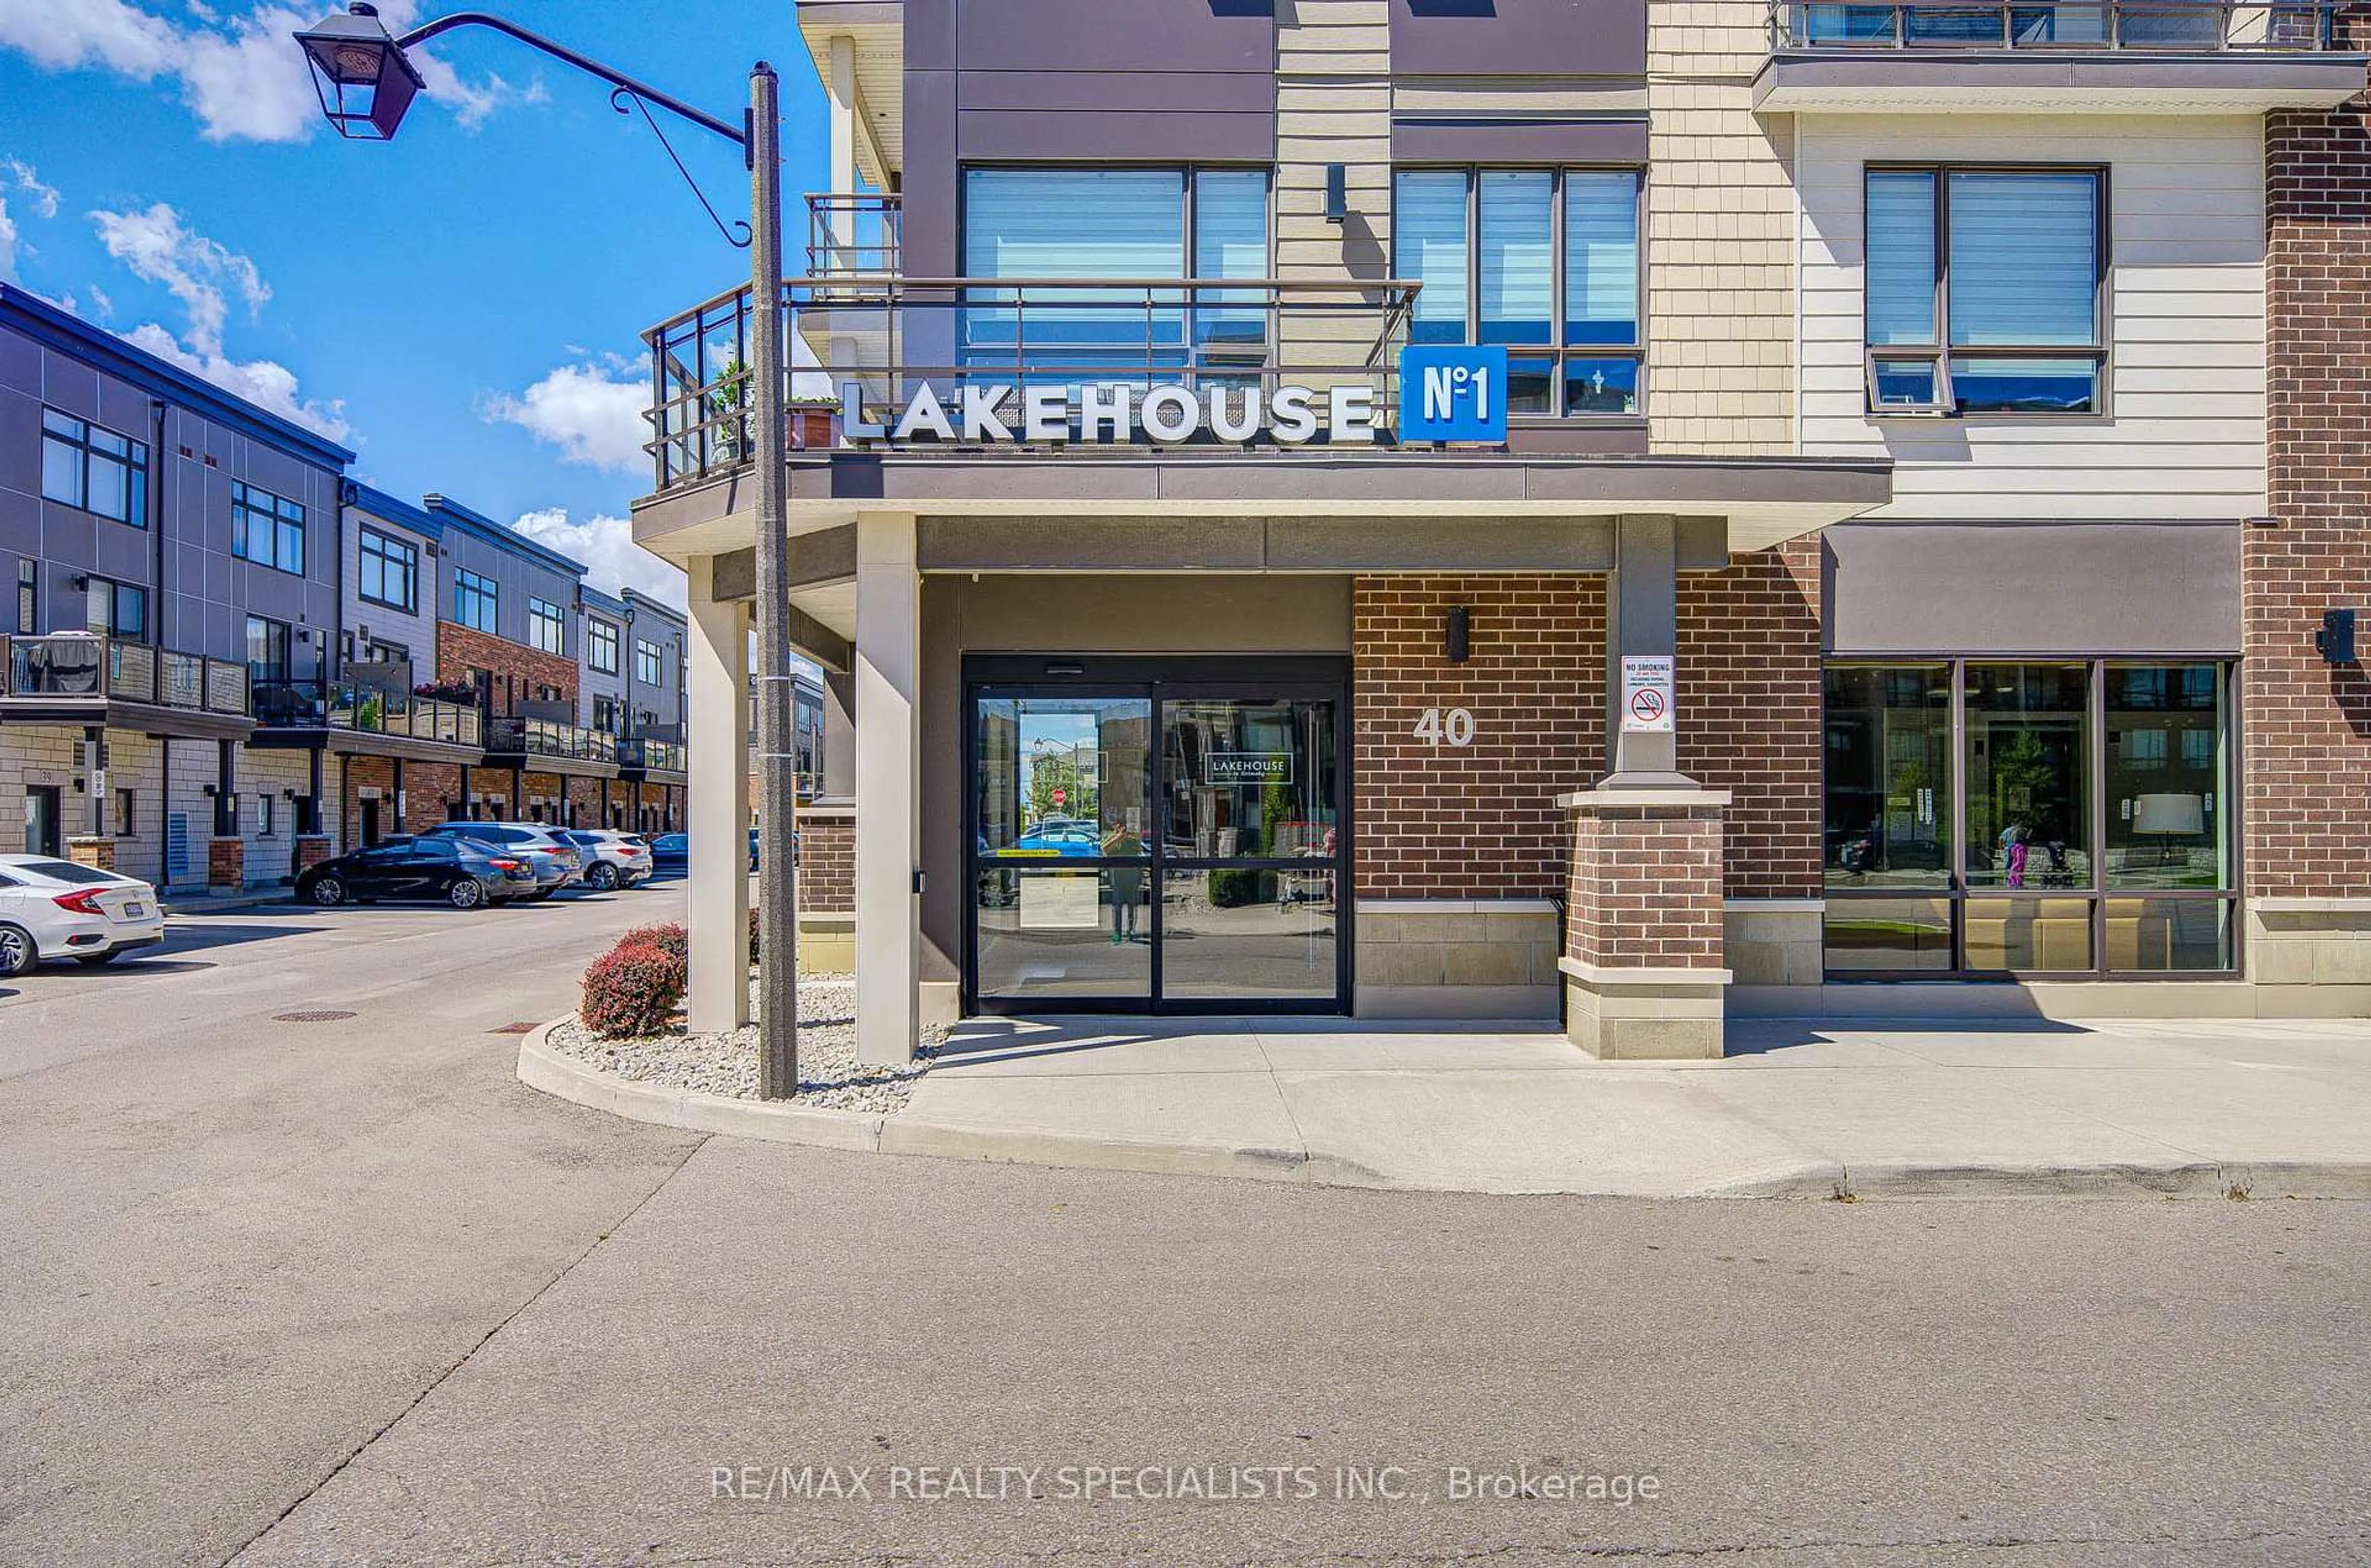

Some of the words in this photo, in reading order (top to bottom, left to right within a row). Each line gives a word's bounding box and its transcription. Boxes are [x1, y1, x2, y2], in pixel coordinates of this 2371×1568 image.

[843, 377, 1374, 441] LAKEHOUSE
[1413, 708, 1474, 748] 40
[1213, 761, 1285, 771] LAKEHOUSE
